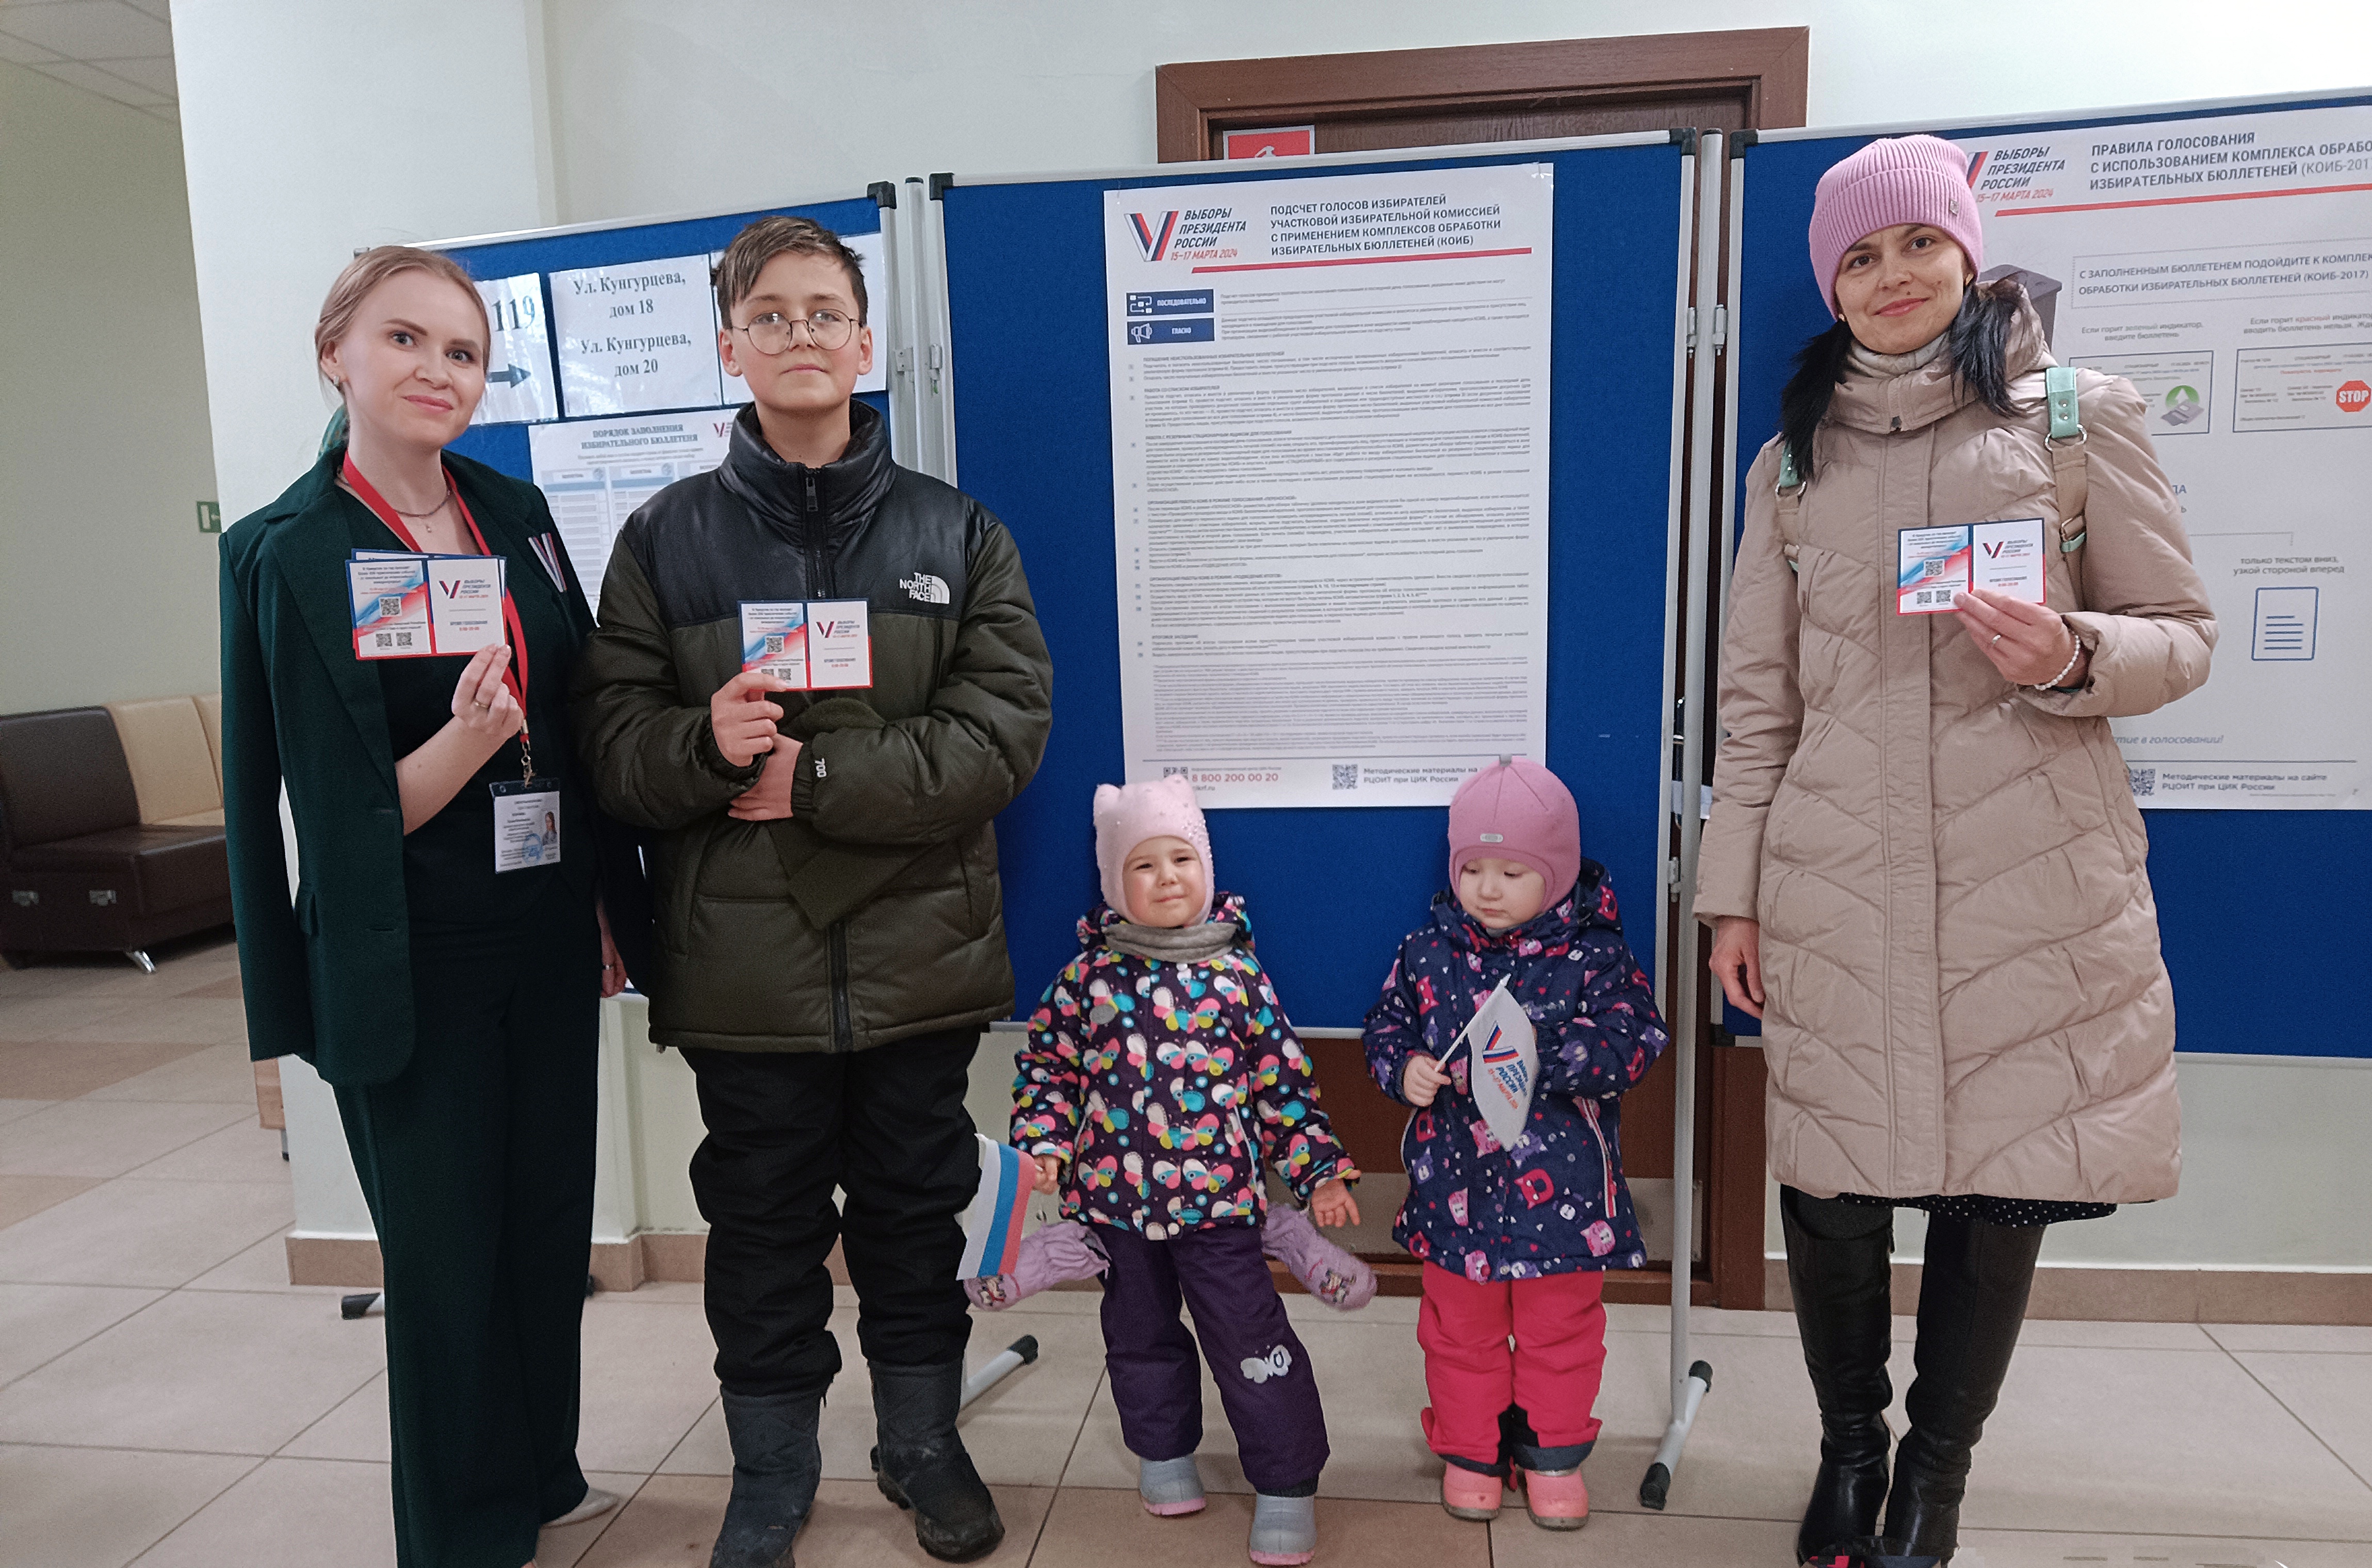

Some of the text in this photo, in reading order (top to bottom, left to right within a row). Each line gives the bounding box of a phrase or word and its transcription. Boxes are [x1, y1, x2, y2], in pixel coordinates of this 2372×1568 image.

[1994, 146, 2051, 161] ВЫБОРЫ
[2092, 132, 2255, 157] ПРАВИЛА ГОЛОСОВАНИЯ
[1987, 159, 2066, 176] ПРЕЗИДЕНТА
[2091, 162, 2099, 173] С
[2103, 151, 2228, 173] ИСПОЛЬЗОВАНИЕМ
[2232, 145, 2315, 162] КОМПЛЕКСА
[1980, 176, 2032, 190] РОССИИ
[2090, 158, 2372, 190] ИЗБИРАТЕЛЬНЫХ БЮЛЛЕТЕНЕЙ (КОИБ-201
[2001, 190, 2030, 202] МАРТА
[2032, 188, 2054, 200] 2024
[1271, 193, 1447, 216] ПОДСЧЕТ ГОЛОСОВ ИЗБИРАТЕЛЕЙ
[1184, 208, 1232, 220] ВЫБОРЫ
[1271, 204, 1500, 228] УЧАСТКОВОЙ ИЗБИРАТЕЛЬНОЙ КОМИССИЕЙ
[1179, 221, 1246, 235] ПРЕЗИДЕНТА
[1271, 220, 1501, 242] С ПРИМЕНЕНИЕМ КОМПЛЕКСОВ ОБРАБОТКИ
[1174, 237, 1217, 249] РОССИИ
[1272, 236, 1473, 256] ИЗБИРАТЕЛЬНЫХ БЮЛЛЕТЕНЕЙ (КОИБ)
[1192, 250, 1217, 259] МАРТА
[1219, 248, 1238, 258] 2024
[2079, 270, 2087, 279] С
[2089, 265, 2169, 279] ЗАПОЛНЕННЫМ
[2171, 260, 2241, 274] БЮЛЛЕТЕНЕМ
[2244, 255, 2310, 270] ПОДОЙДИТЕ
[2313, 256, 2320, 265] К
[574, 272, 686, 295] Ул. Кунгурцева,
[2079, 269, 2368, 295] ОБРАБОТКИ ИЗБИРАТЕЛЬНЫХ БЮЛЛЕТЕНЕЙ (КОИБ-2017)
[492, 295, 535, 332] 119
[609, 299, 654, 319] дом 18
[581, 333, 691, 354] Ул. Кунгурцева,
[614, 359, 659, 378] дом 20
[2338, 390, 2369, 403] STOP
[914, 572, 932, 584] THE
[2233, 566, 2260, 576] узкой
[2262, 566, 2307, 574] стороной
[899, 578, 931, 593] NORTH
[909, 589, 931, 602] FACE
[815, 757, 826, 777] 700
[1192, 773, 1278, 782] 8 800 200 00 20
[2218, 782, 2238, 791] ЦИК
